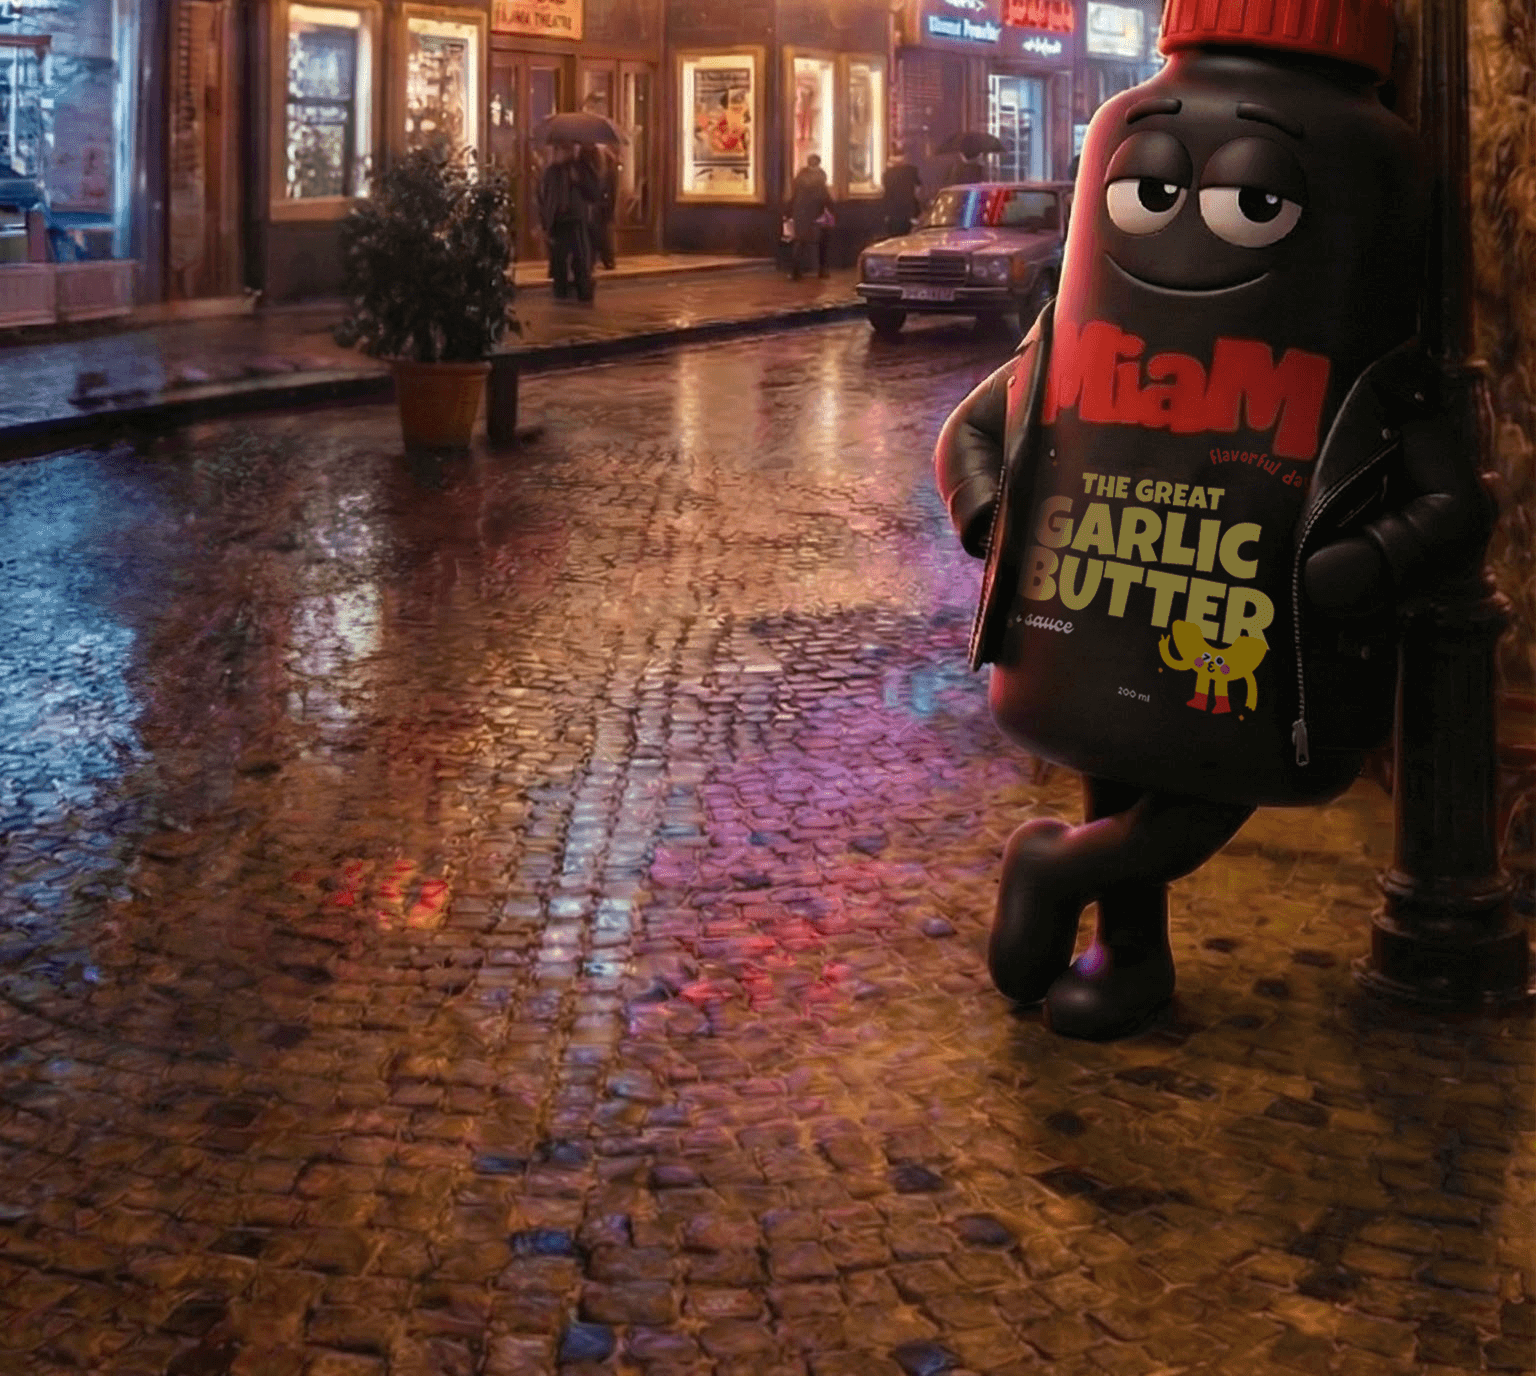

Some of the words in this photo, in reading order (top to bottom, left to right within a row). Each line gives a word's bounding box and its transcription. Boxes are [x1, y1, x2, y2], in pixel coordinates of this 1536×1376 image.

[1209, 448, 1283, 476] flavorful
[1082, 472, 1129, 500] THE
[1135, 479, 1226, 511] GREAT
[1036, 494, 1262, 580] GARLIC
[1020, 545, 1275, 651] BUTTER
[1024, 613, 1074, 635] sauce
[1117, 686, 1137, 699] 200
[1138, 692, 1151, 703] ml
